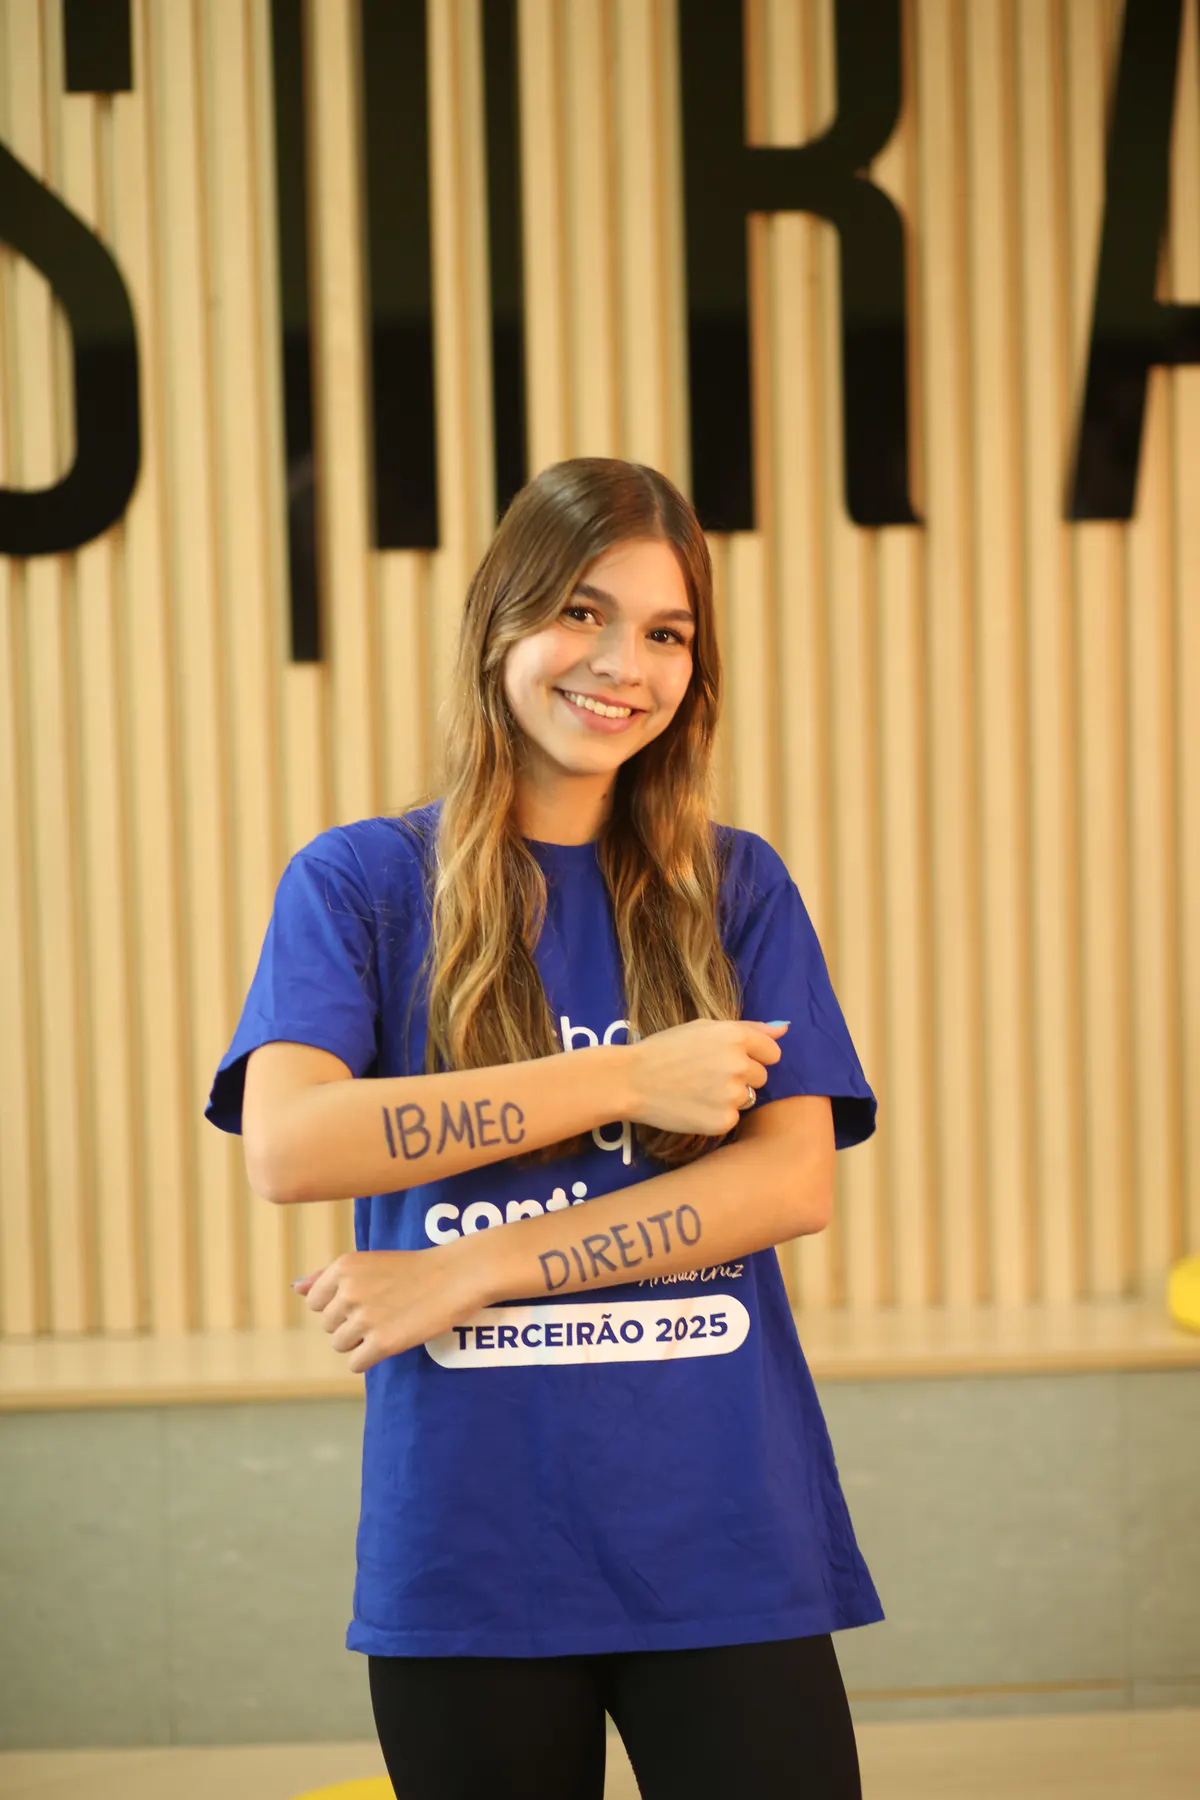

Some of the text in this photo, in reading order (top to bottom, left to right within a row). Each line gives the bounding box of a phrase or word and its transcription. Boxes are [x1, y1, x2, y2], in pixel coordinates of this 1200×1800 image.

[382, 1098, 526, 1161] IBMEC
[538, 1204, 702, 1292] DIREITO
[452, 1312, 729, 1350] TERCEIRÃO 2025
